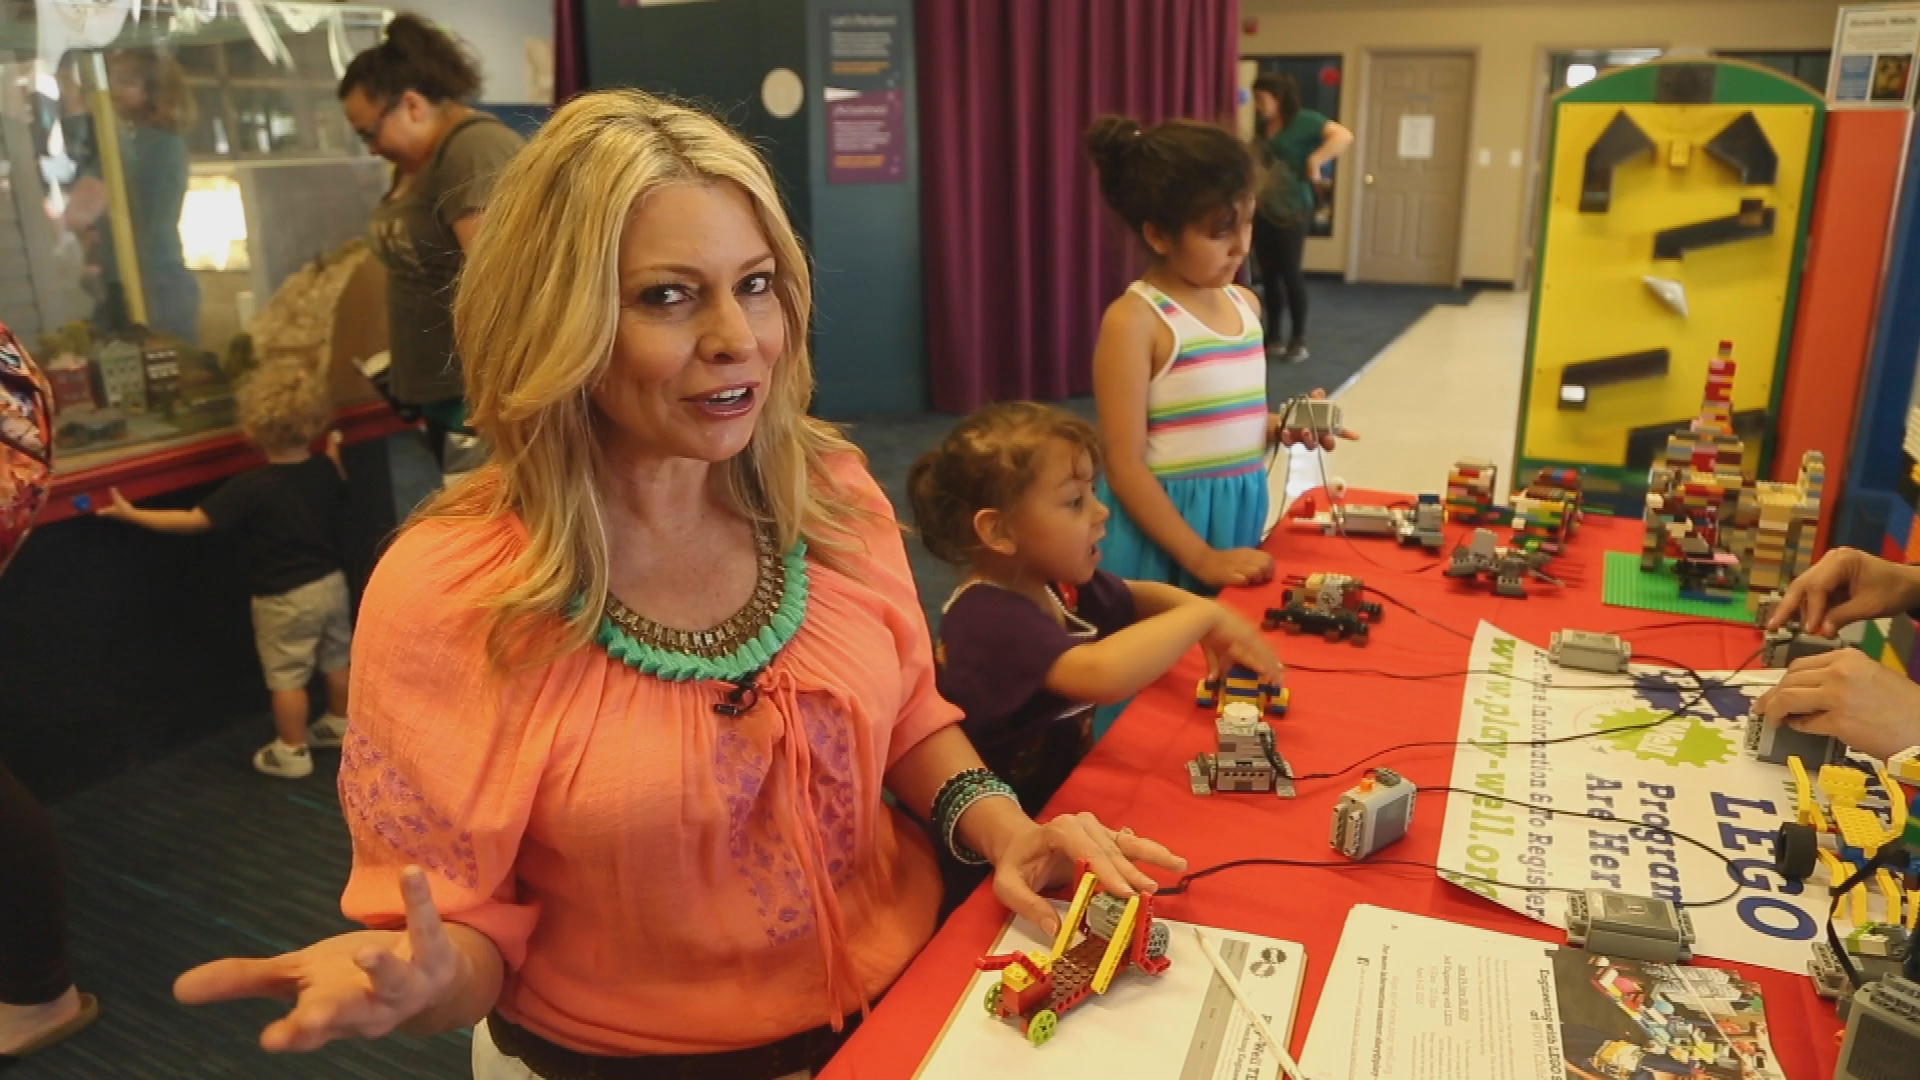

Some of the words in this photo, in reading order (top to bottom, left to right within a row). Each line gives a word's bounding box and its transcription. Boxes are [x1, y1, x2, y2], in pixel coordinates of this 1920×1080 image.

[1585, 772, 1622, 820] Are
[1710, 791, 1818, 940] LEGO
[1537, 968, 1554, 1021] Engineering
[1546, 1023, 1558, 1044] with
